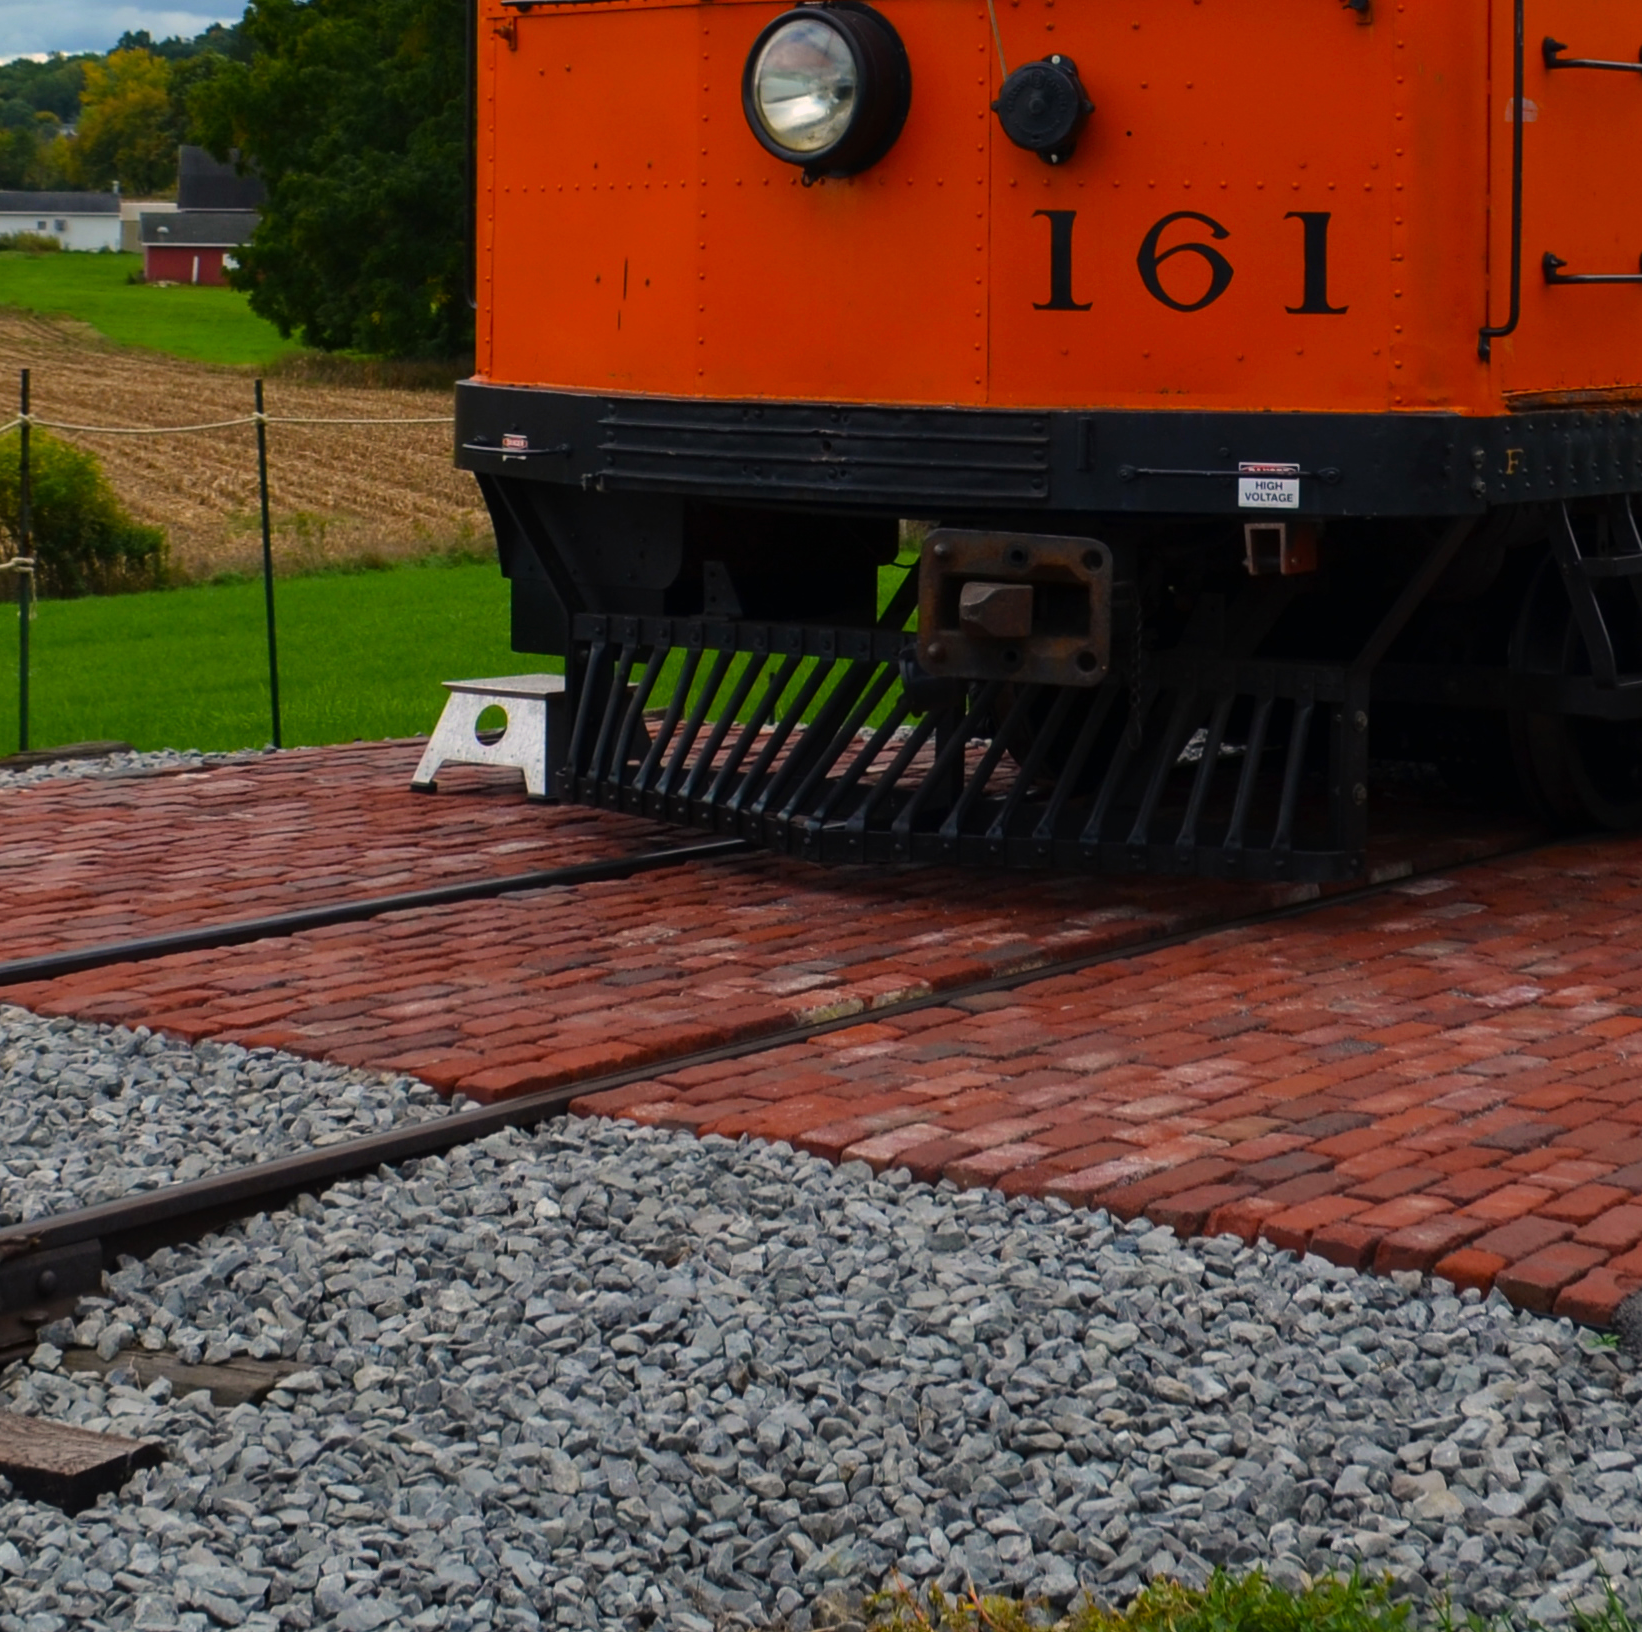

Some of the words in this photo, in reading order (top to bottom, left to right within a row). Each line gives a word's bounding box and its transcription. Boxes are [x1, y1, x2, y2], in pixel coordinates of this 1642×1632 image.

[1031, 209, 1350, 315] 161
[1505, 448, 1524, 475] F
[1255, 481, 1283, 491] HIGH
[1245, 492, 1293, 503] VOLTAGE
